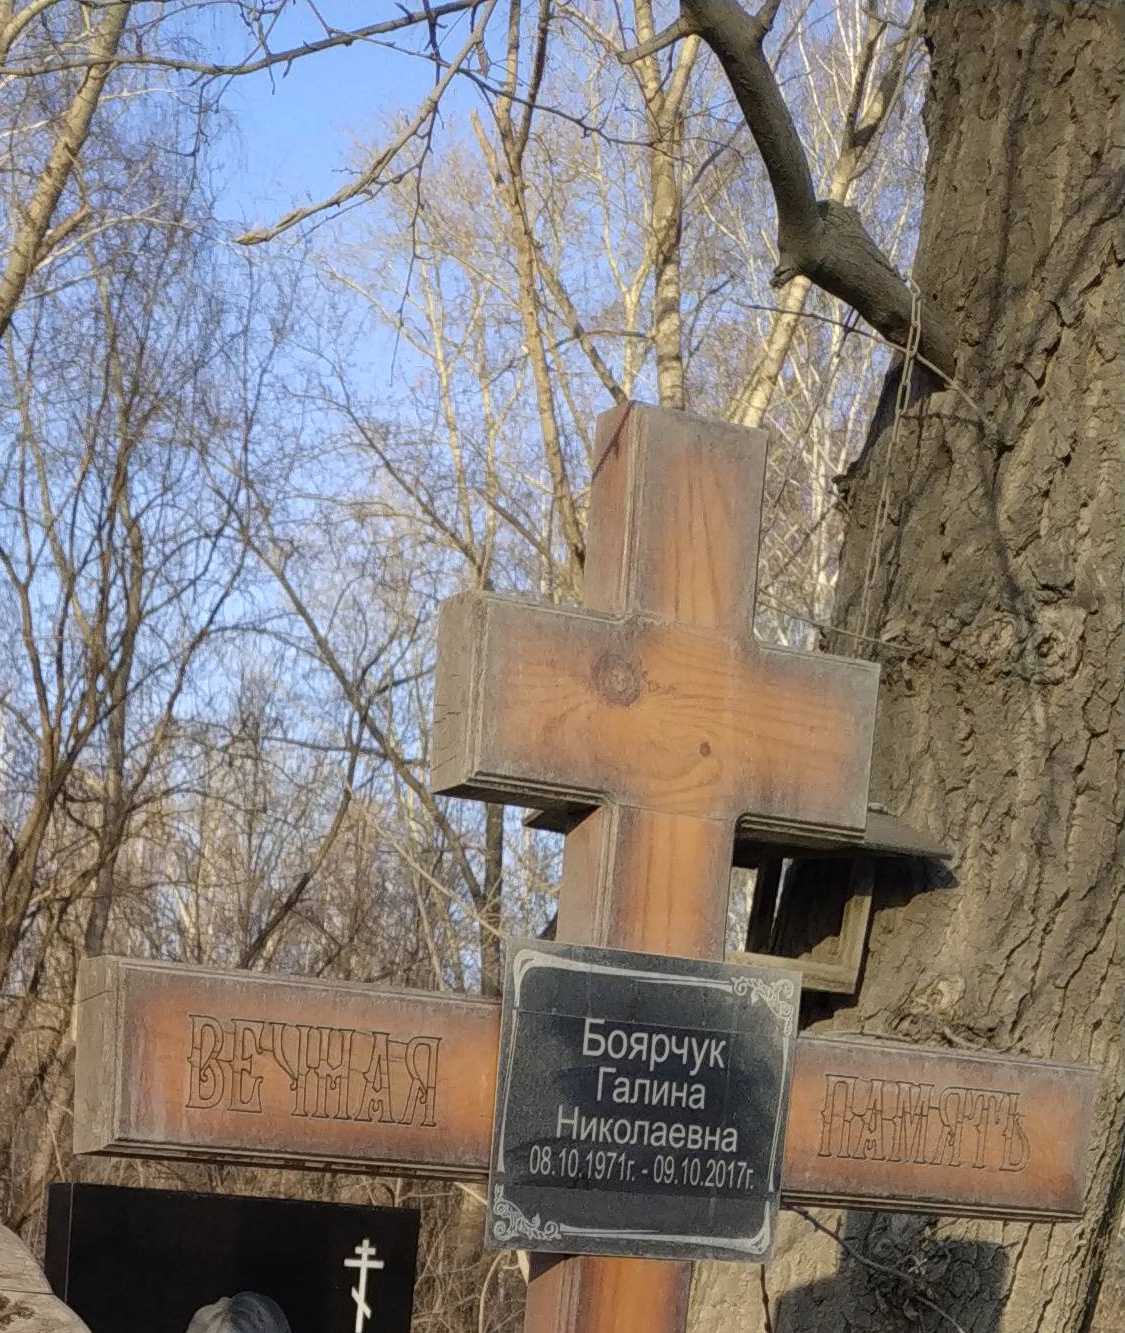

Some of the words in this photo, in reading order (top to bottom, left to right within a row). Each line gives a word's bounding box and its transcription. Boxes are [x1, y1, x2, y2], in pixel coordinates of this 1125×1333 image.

[582, 1018, 727, 1076] Боярчук
[184, 1014, 443, 1127] ВЕЧНАЯ
[817, 1073, 1031, 1172] ПАМЯТЬ
[595, 1067, 707, 1110] Галина
[556, 1105, 738, 1153] Николаевна
[529, 1145, 635, 1182] 08.10.1971г.
[653, 1154, 755, 1190] 09.10.2017г.
